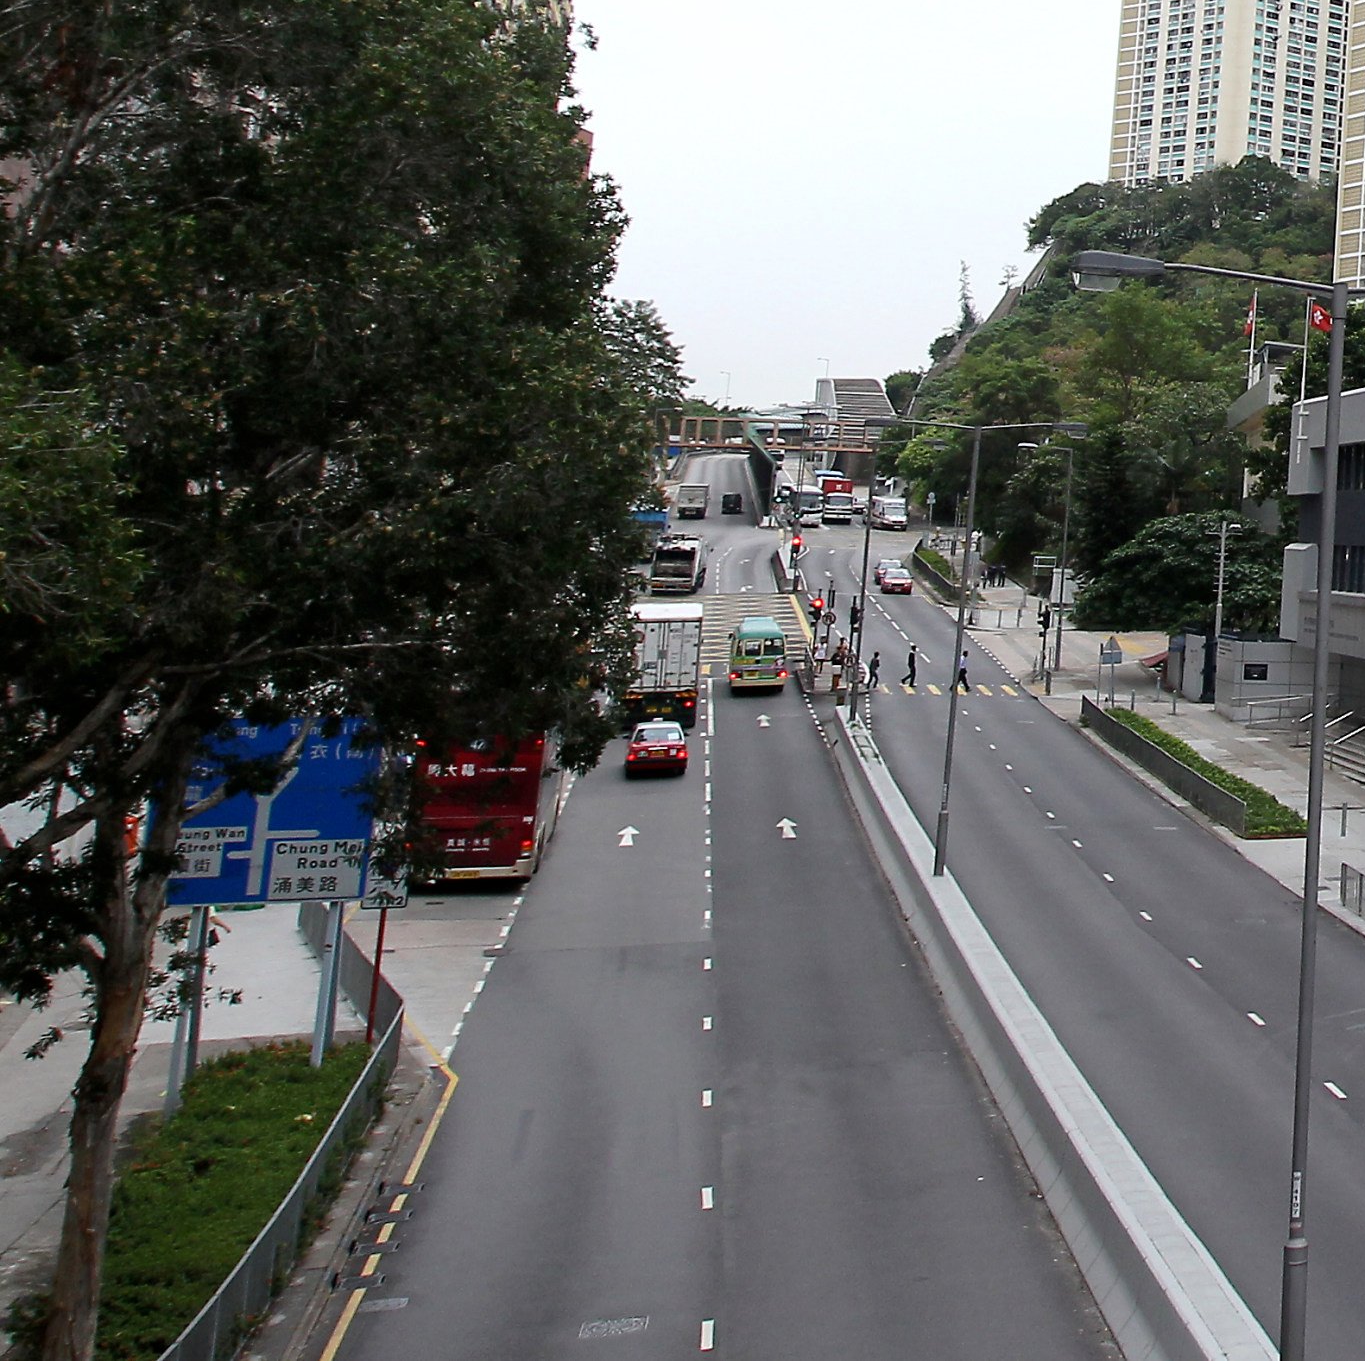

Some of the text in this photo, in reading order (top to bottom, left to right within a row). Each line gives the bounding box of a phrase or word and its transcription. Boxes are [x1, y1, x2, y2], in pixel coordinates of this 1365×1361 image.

[215, 828, 245, 839] Wan
[176, 842, 222, 853] Street
[276, 841, 363, 854] Chung Mei
[297, 857, 338, 869] Road
[272, 875, 338, 894] 涌美路
